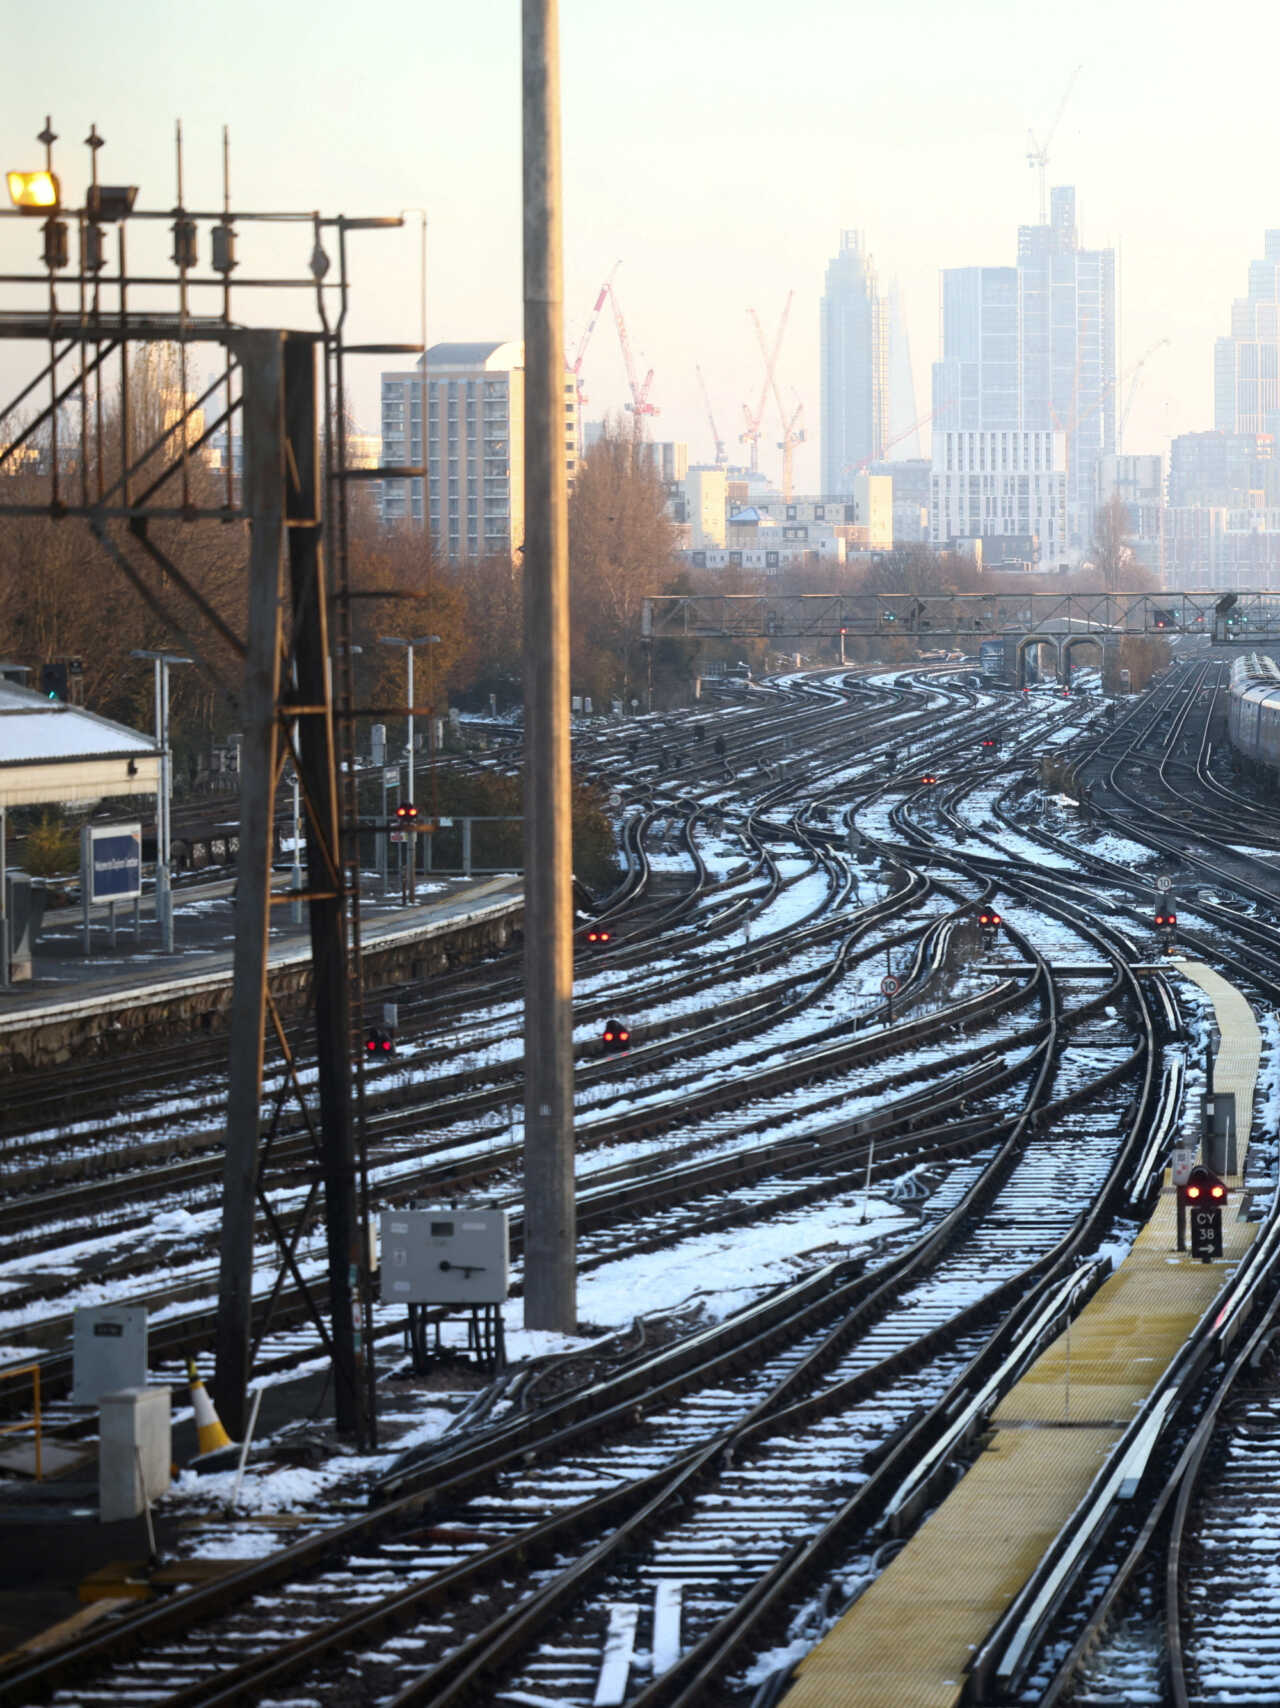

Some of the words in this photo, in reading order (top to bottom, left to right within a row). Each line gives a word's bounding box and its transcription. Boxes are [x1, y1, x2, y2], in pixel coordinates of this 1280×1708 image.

[1159, 879, 1169, 888] 10
[884, 980, 897, 992] 10
[1196, 1213, 1216, 1225] CY
[1199, 1228, 1215, 1240] 38
